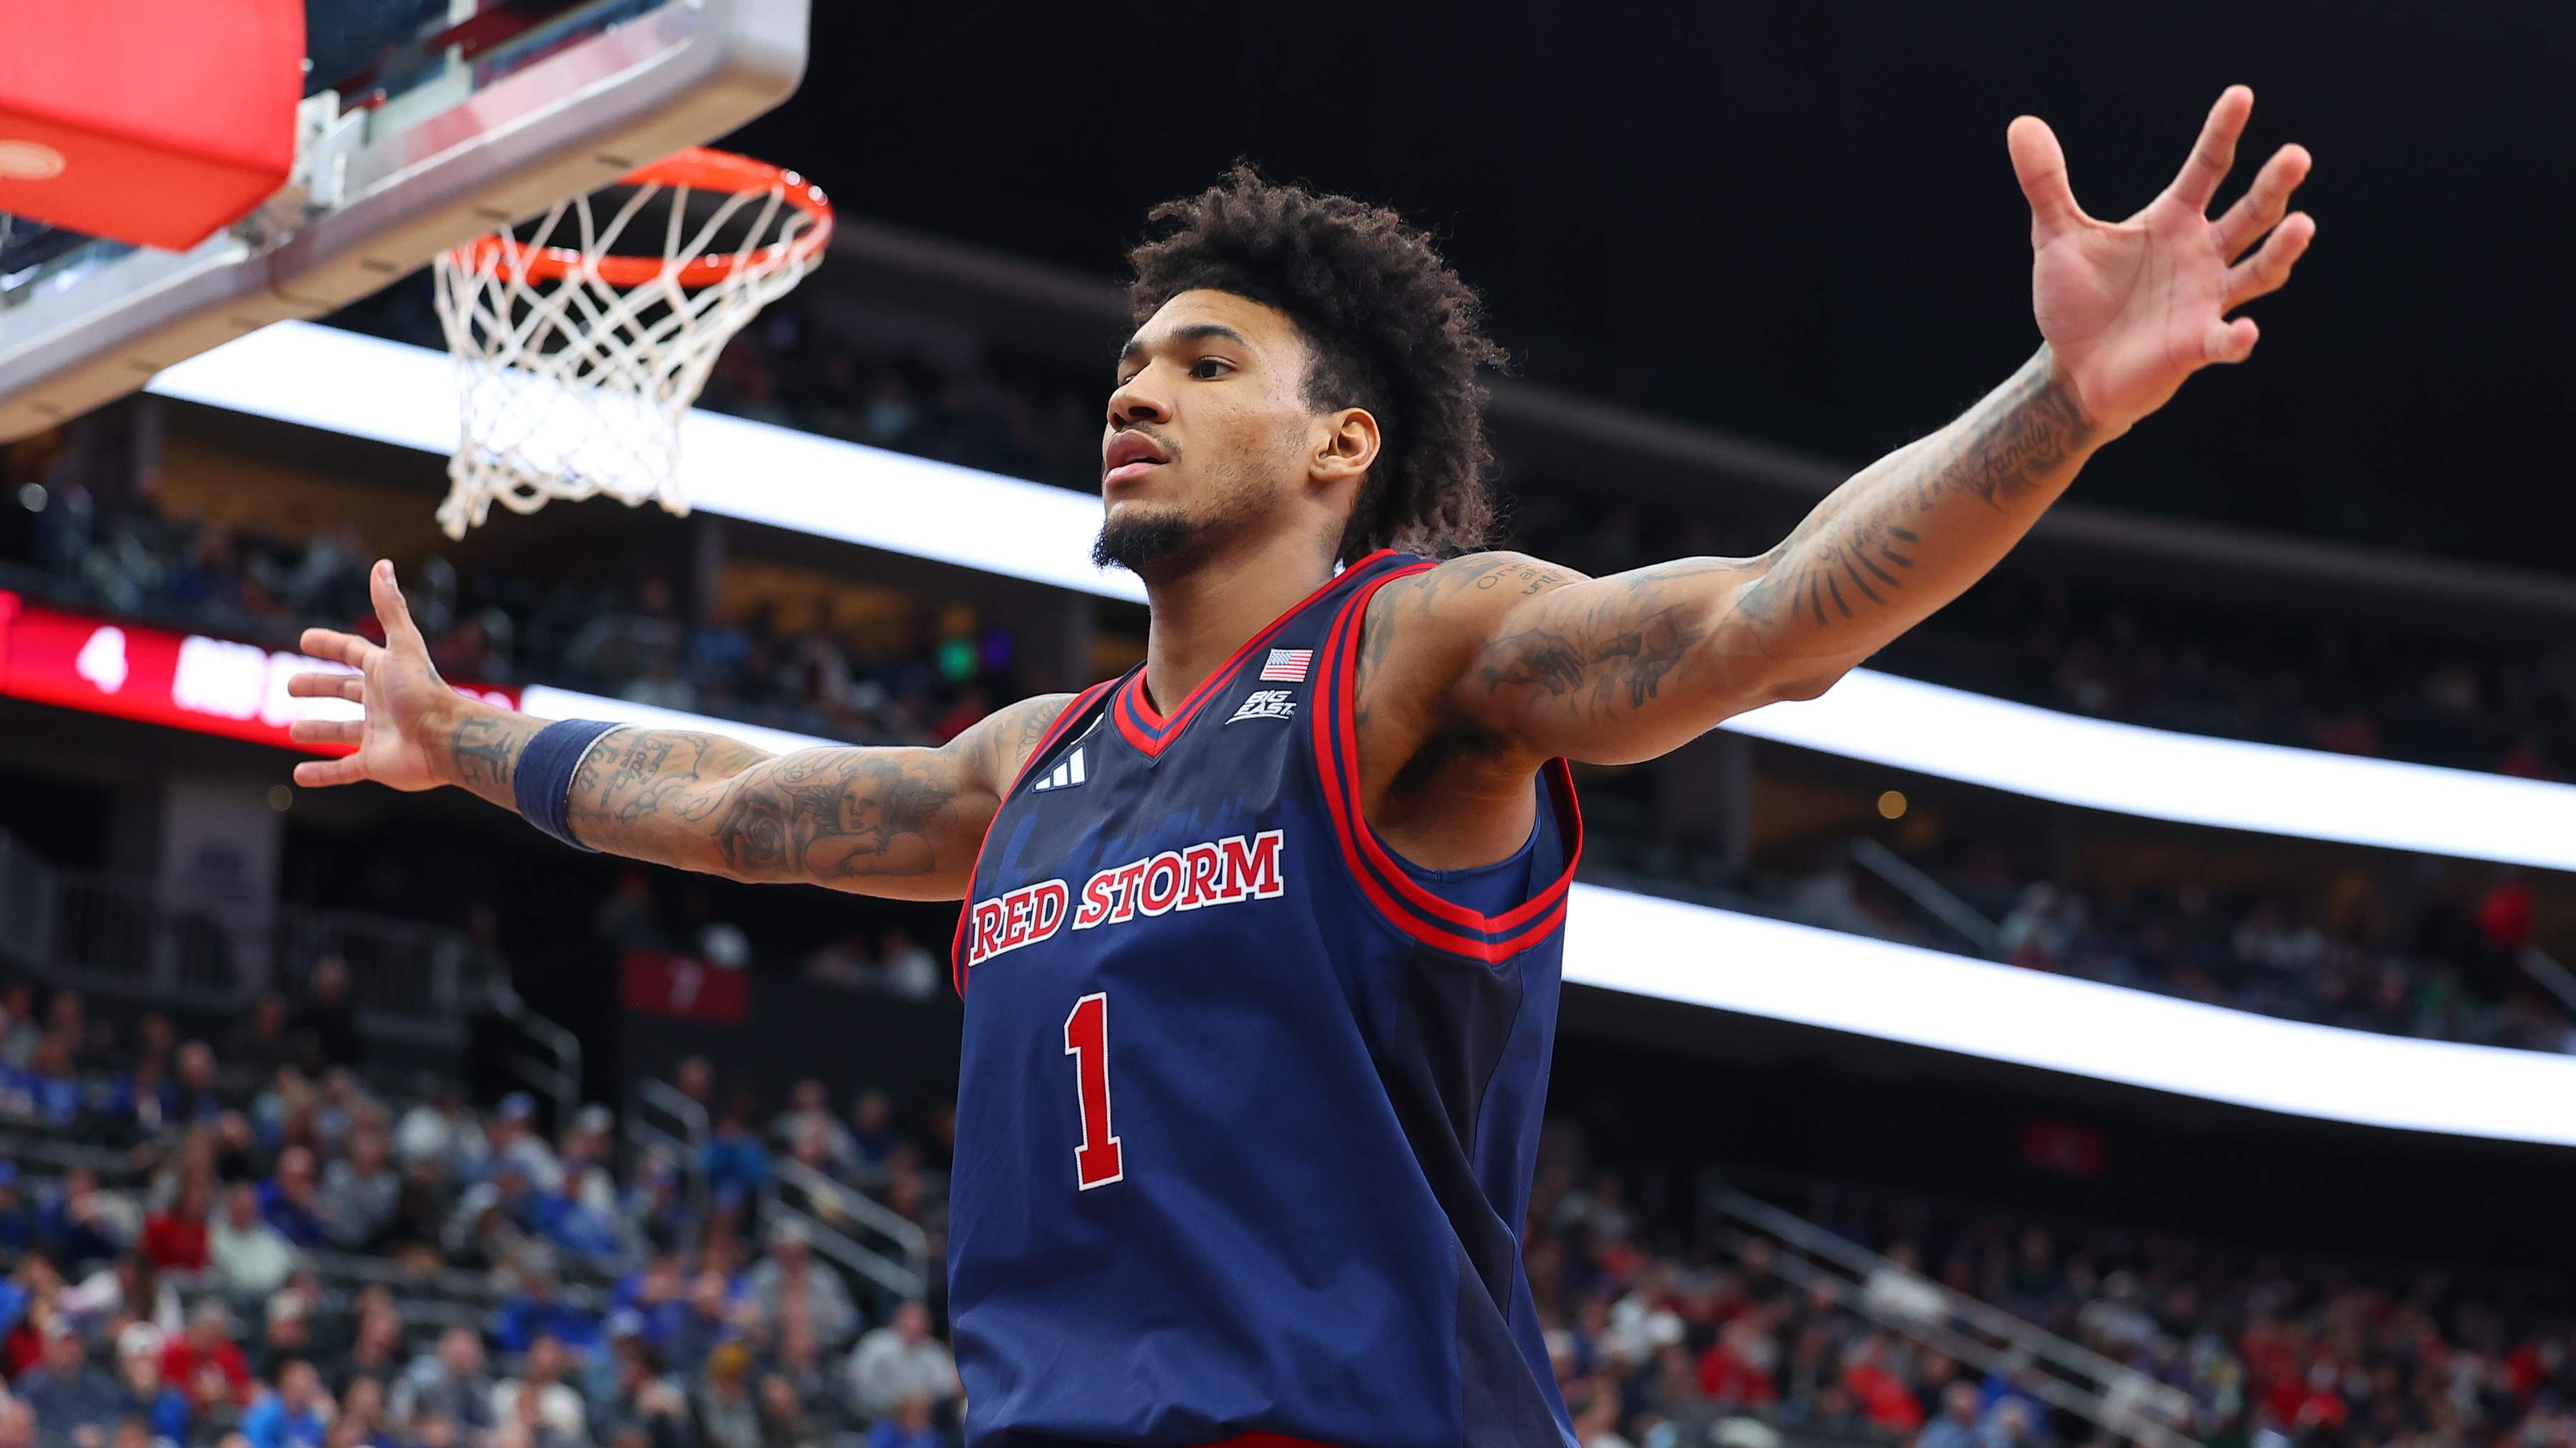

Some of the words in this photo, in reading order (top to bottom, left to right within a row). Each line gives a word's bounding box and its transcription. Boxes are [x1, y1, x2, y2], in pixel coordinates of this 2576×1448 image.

[76, 625, 129, 694] 4
[1234, 703, 1297, 716] EAST
[1244, 690, 1292, 704] BIG
[968, 878, 1069, 967] RED
[1072, 828, 1284, 930] STORM
[1063, 991, 1123, 1191] 1
